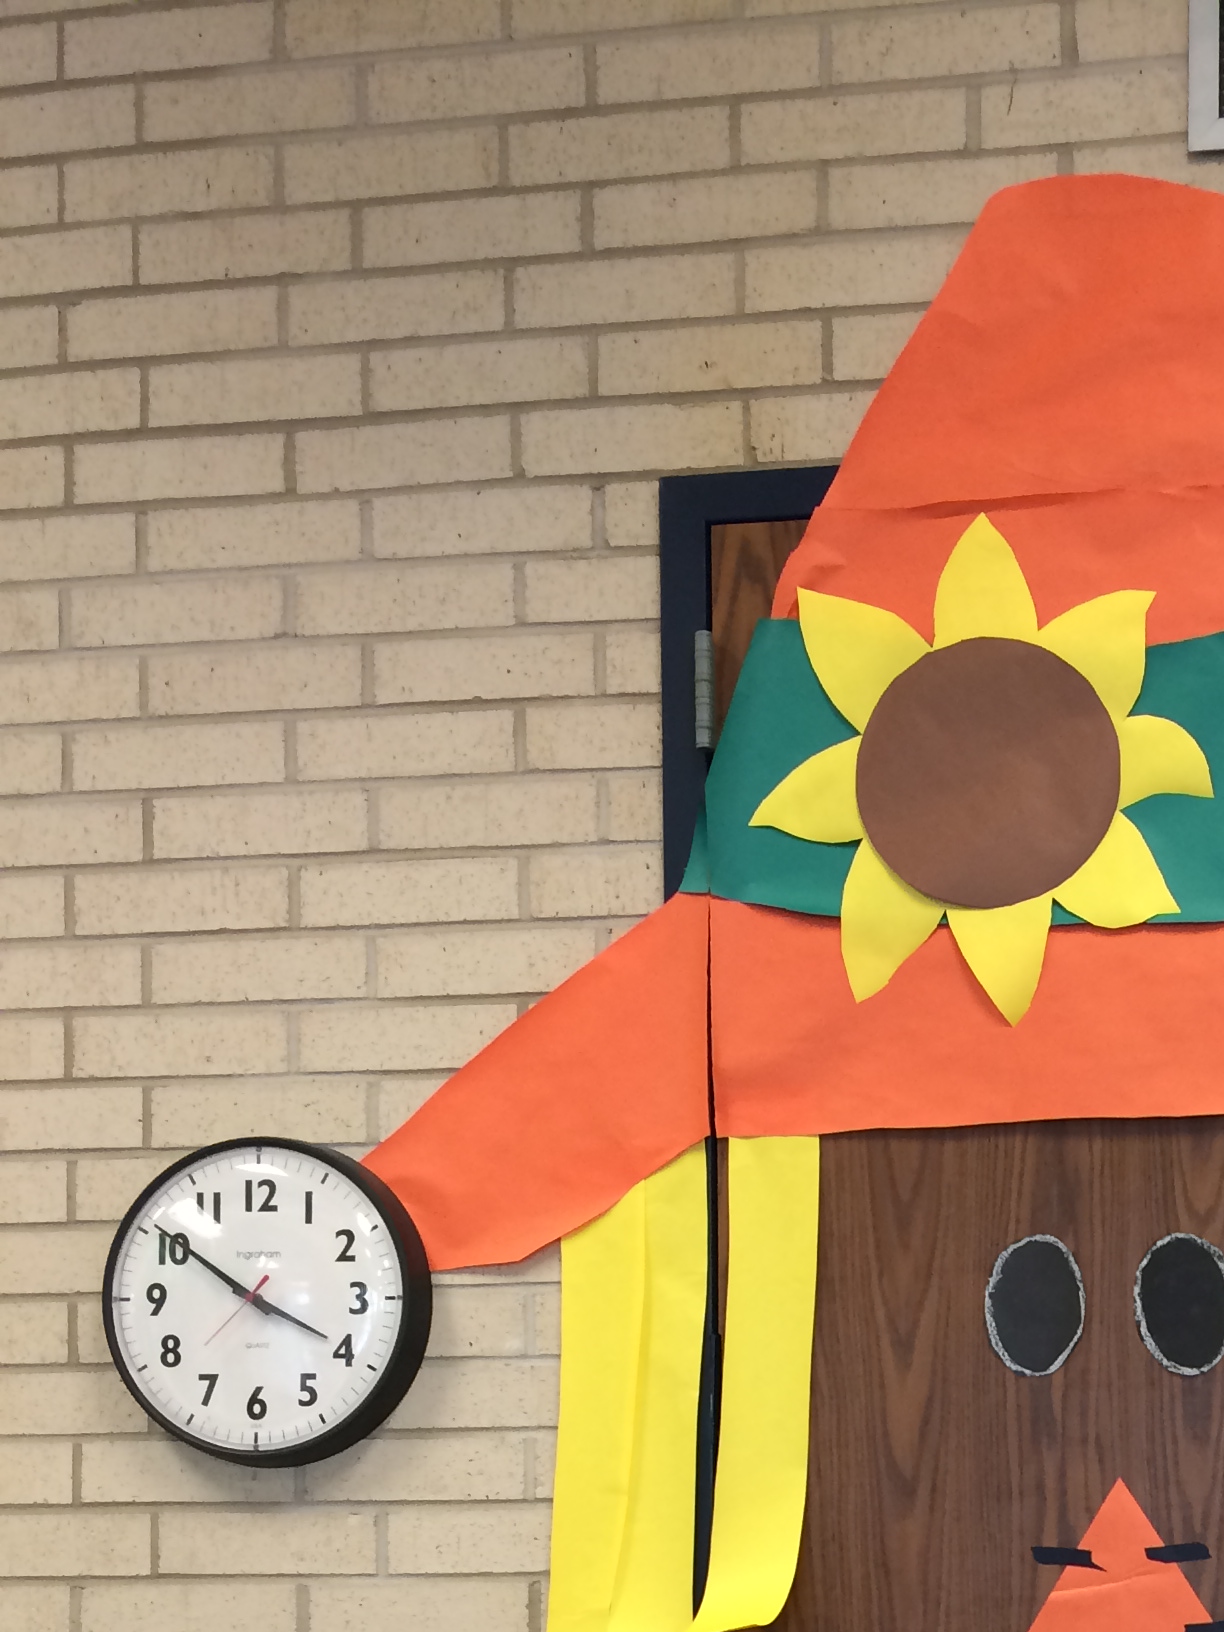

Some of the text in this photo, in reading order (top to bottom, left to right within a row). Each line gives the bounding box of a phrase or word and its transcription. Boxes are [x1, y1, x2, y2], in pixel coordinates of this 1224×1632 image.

[196, 1192, 221, 1224] 11
[245, 1179, 278, 1212] 12
[305, 1191, 313, 1224] 1
[158, 1232, 190, 1265] 10
[236, 1250, 281, 1260] Ingraham
[335, 1229, 356, 1262] 2
[146, 1283, 167, 1316] 9
[349, 1281, 369, 1315] 3
[160, 1334, 182, 1368] 8
[333, 1333, 355, 1367] 4
[198, 1373, 219, 1407] 7
[246, 1386, 267, 1420] 6
[298, 1373, 318, 1407] 5
